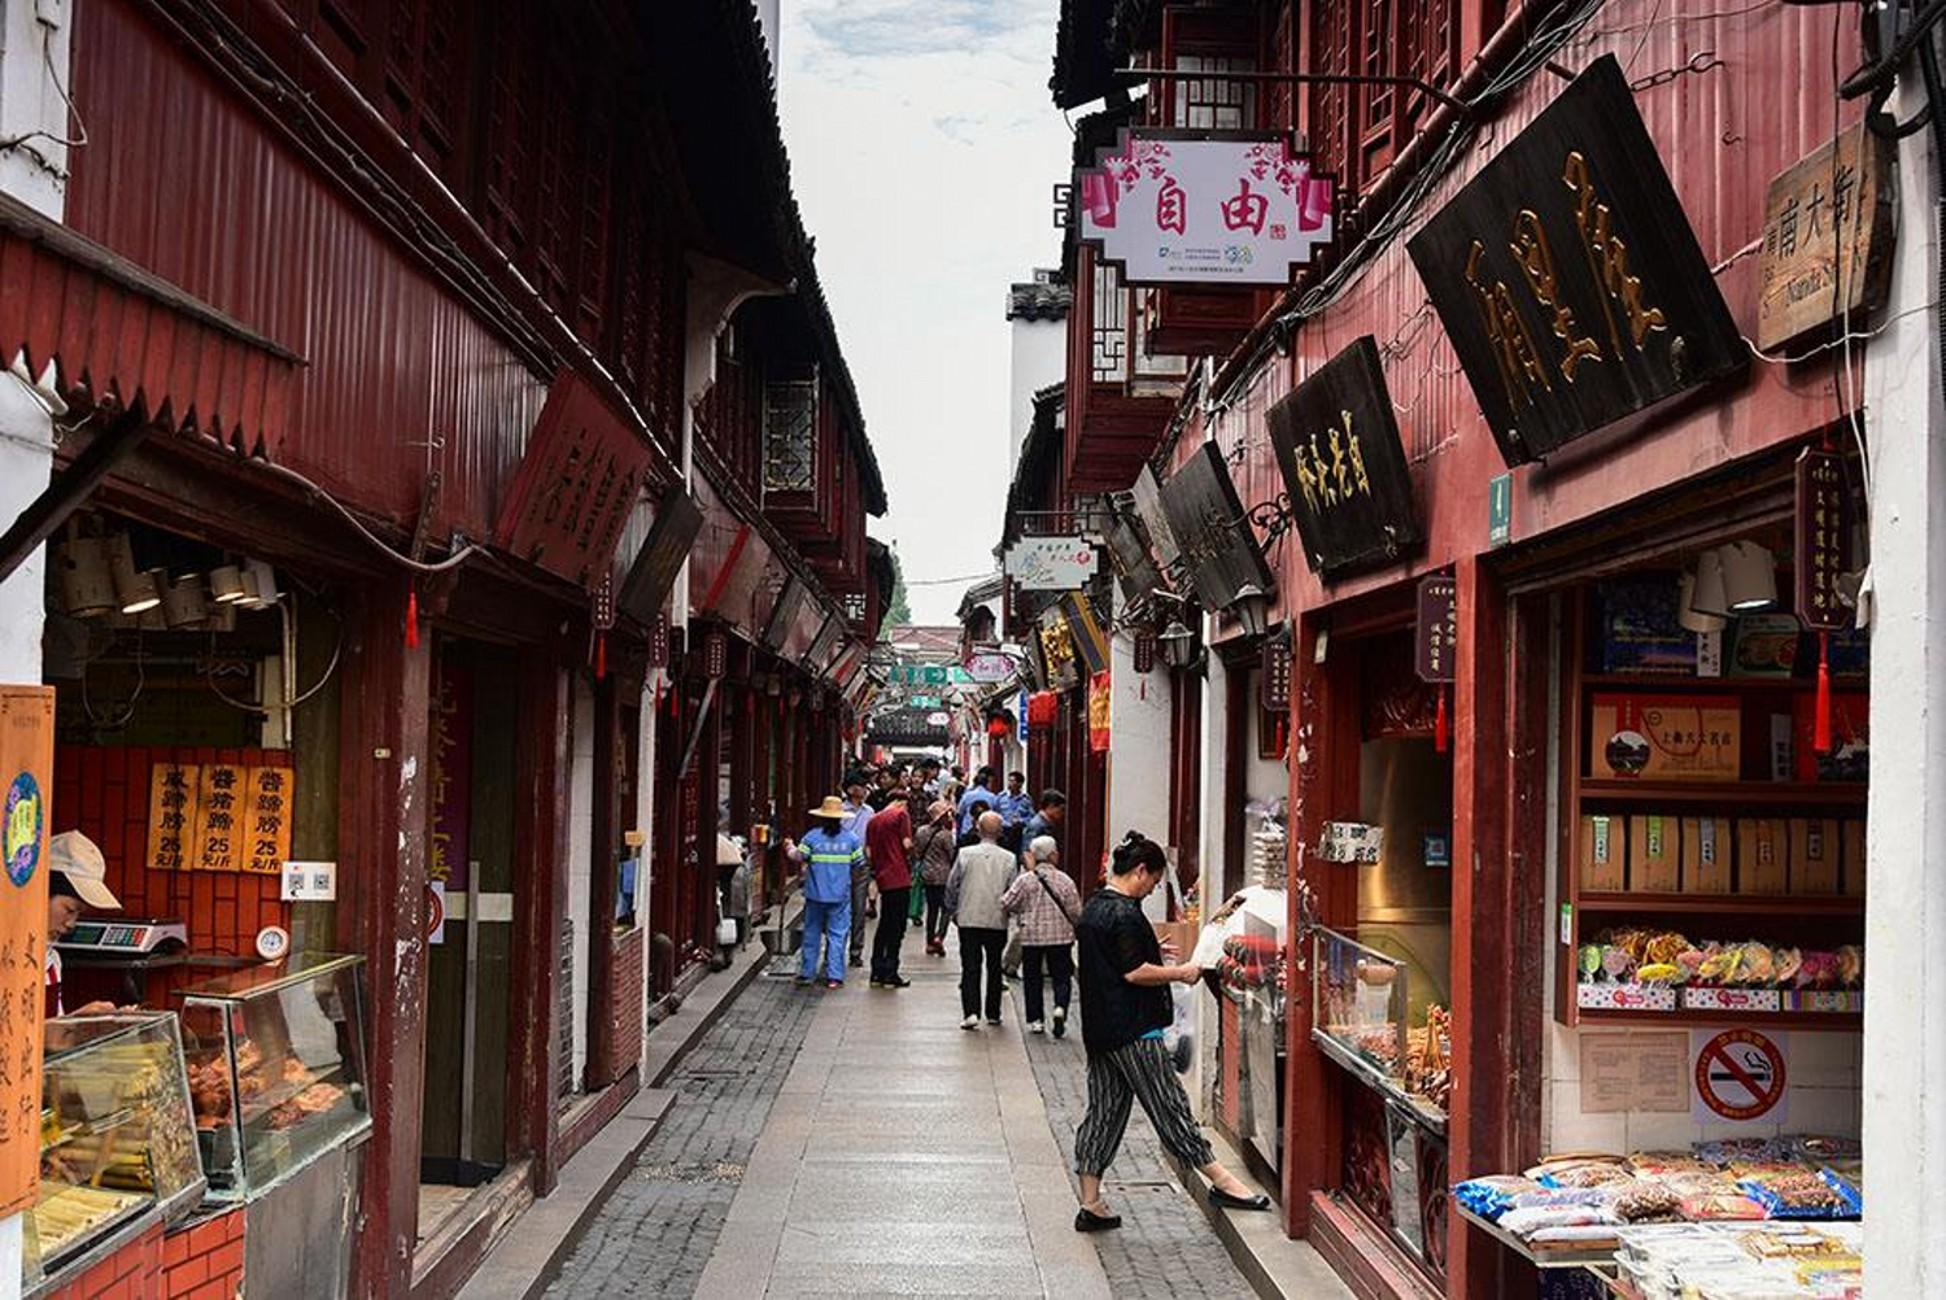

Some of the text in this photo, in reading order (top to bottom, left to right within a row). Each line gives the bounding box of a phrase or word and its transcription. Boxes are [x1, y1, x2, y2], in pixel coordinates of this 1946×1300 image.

[1157, 176, 1269, 236] 自由
[160, 837, 182, 853] 25
[208, 837, 229, 853] 25
[255, 840, 277, 856] 25
